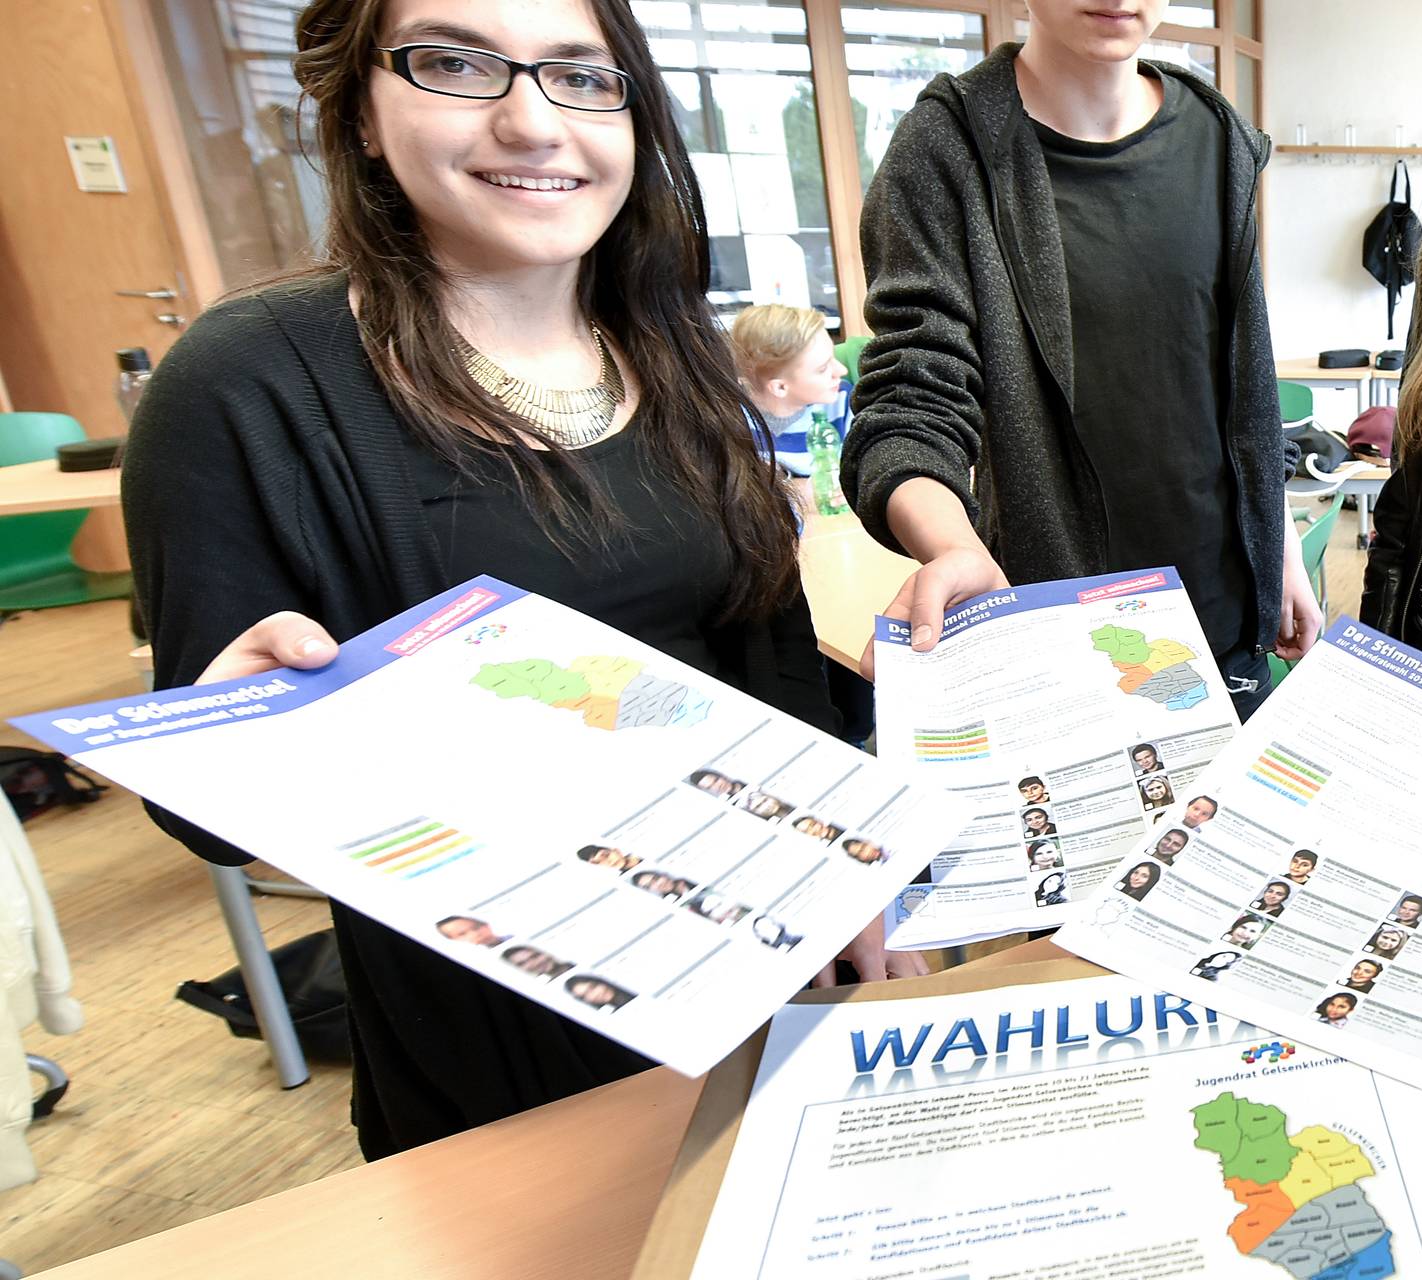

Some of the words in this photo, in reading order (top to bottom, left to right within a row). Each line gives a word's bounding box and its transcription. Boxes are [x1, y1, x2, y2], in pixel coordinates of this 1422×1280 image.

[888, 623, 911, 636] De
[943, 592, 1018, 627] mmzettel
[1342, 625, 1372, 645] Der
[1336, 638, 1350, 648] zur
[1349, 643, 1409, 677] Jugendratswahl
[51, 713, 119, 735] Der
[117, 678, 297, 723] Stimmzettel
[1195, 1070, 1257, 1087] Jugendrat
